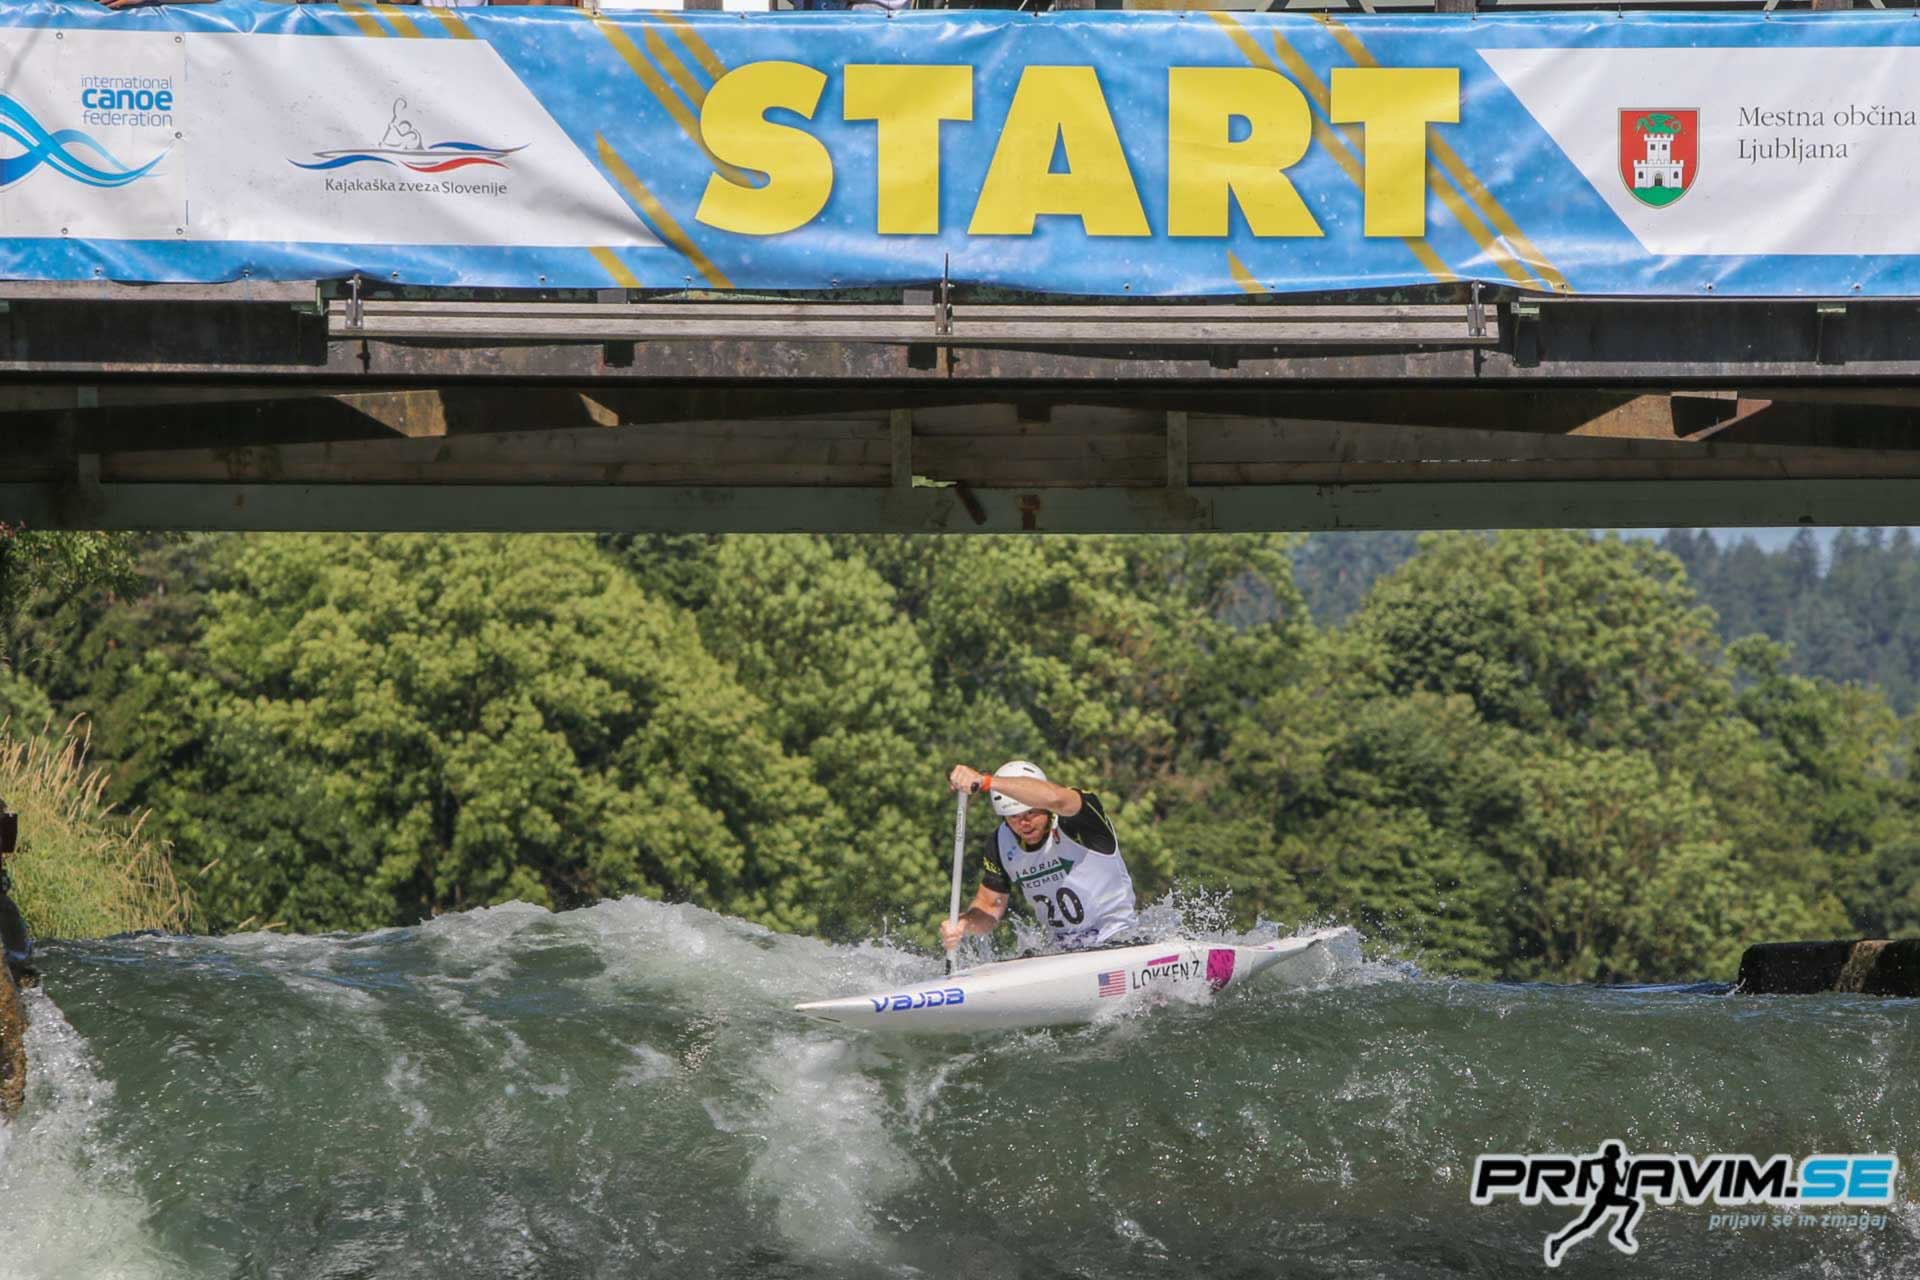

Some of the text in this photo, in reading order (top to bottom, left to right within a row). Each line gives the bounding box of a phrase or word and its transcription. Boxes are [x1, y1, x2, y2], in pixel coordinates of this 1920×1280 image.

[81, 75, 174, 89] international
[82, 88, 173, 111] canoe
[83, 110, 173, 127] federation
[1738, 104, 1917, 127] Mestna občina
[694, 60, 1461, 237] START
[1738, 137, 1849, 165] Ljubljana
[325, 178, 508, 197] Kajakaška zveza Slovenije
[1022, 859, 1060, 876] ADRIA
[1026, 872, 1065, 889] KOMBI
[1033, 887, 1085, 928] 20
